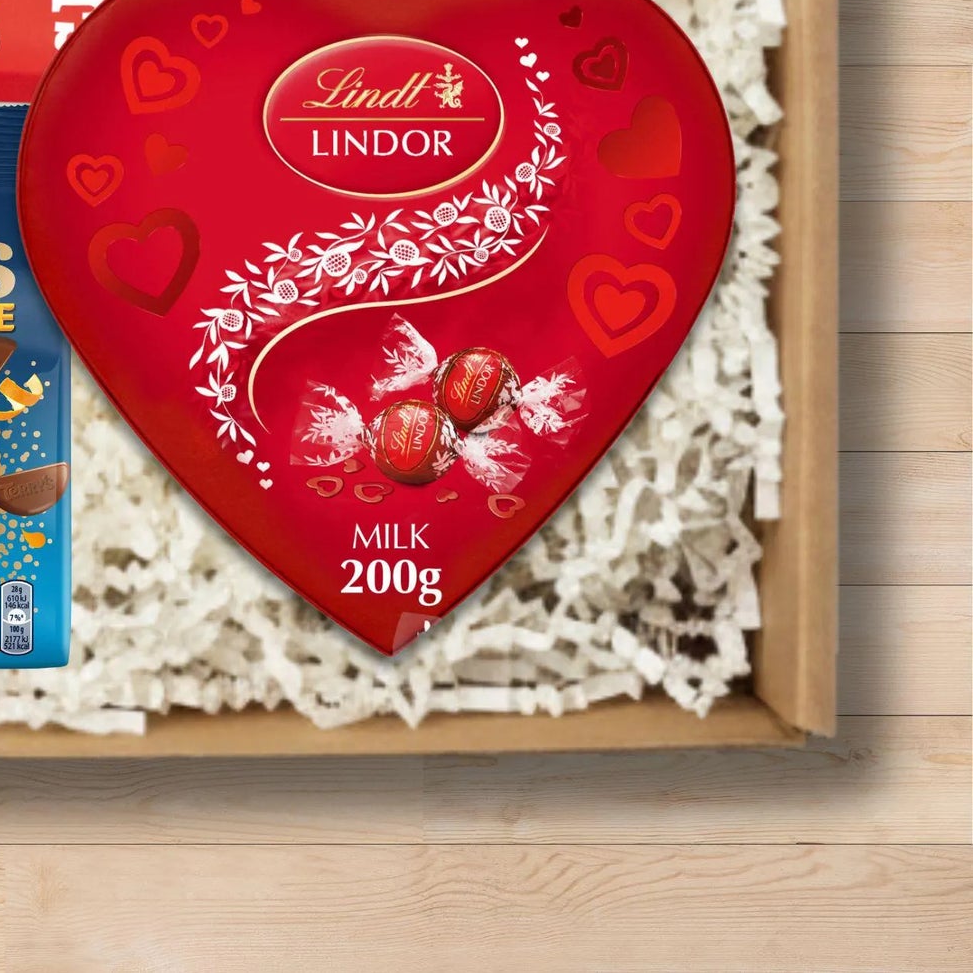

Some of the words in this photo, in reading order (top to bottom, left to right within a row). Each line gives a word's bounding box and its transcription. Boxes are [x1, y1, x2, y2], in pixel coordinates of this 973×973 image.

[302, 67, 434, 109] Lindt
[312, 129, 454, 157] LINDOR
[471, 364, 495, 405] LINDOR
[352, 523, 430, 549] MILK
[340, 559, 443, 607] 200g
